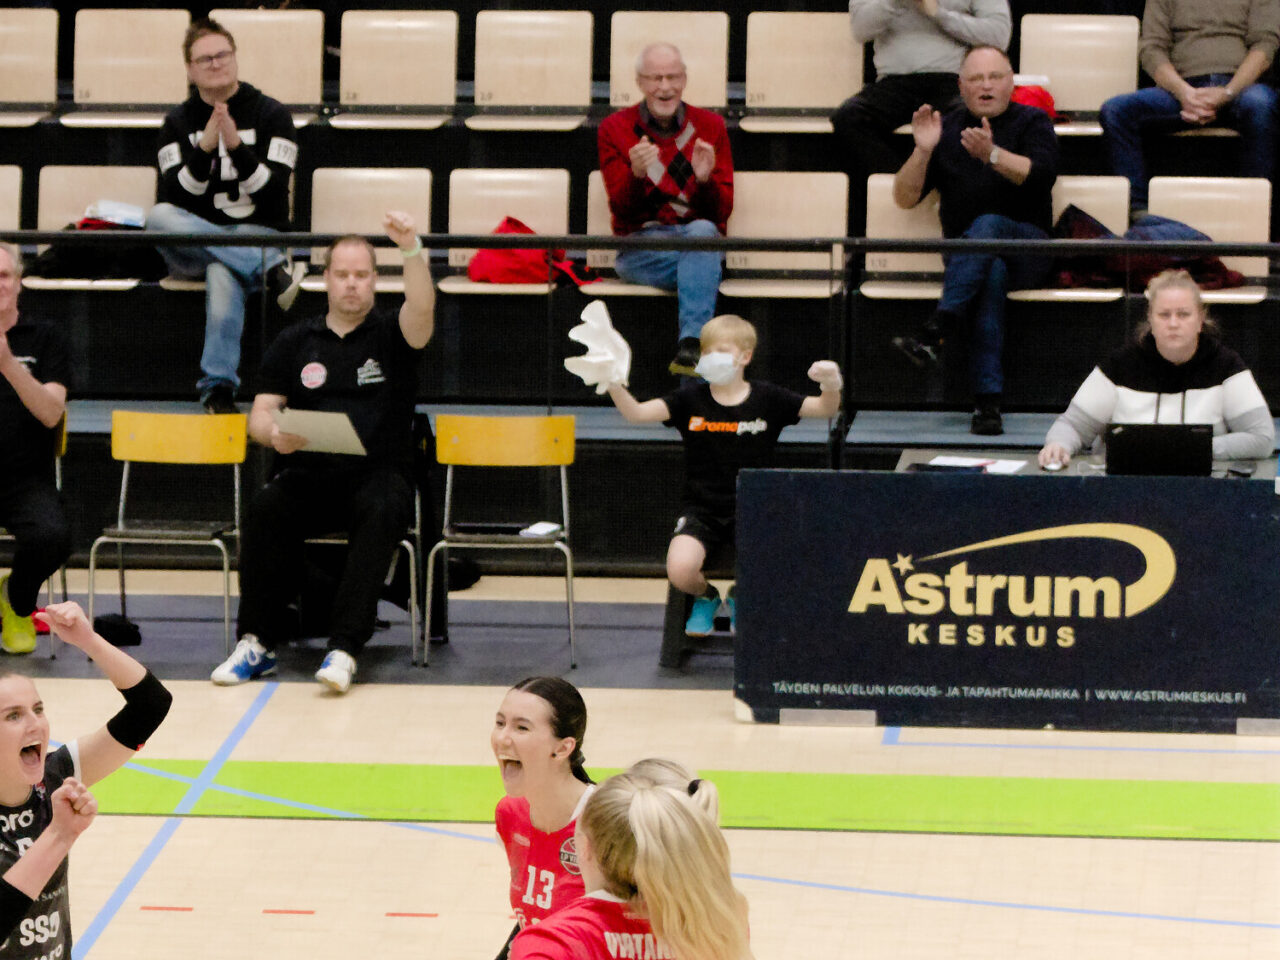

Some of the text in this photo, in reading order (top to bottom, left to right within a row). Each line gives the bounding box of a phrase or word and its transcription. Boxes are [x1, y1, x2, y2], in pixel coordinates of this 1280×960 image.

[847, 558, 1126, 619] Astrum
[907, 624, 1077, 648] KESKUS
[772, 681, 820, 695] TÄYDEN
[822, 683, 887, 697] PALVELUN
[888, 685, 942, 698] KOKOUS-
[945, 686, 960, 698] JA
[962, 687, 1080, 701] TAPAHTUMAPAIKKA
[1094, 690, 1247, 705] WWW.ASTRUMKESKUS.FI
[522, 865, 555, 909] 13
